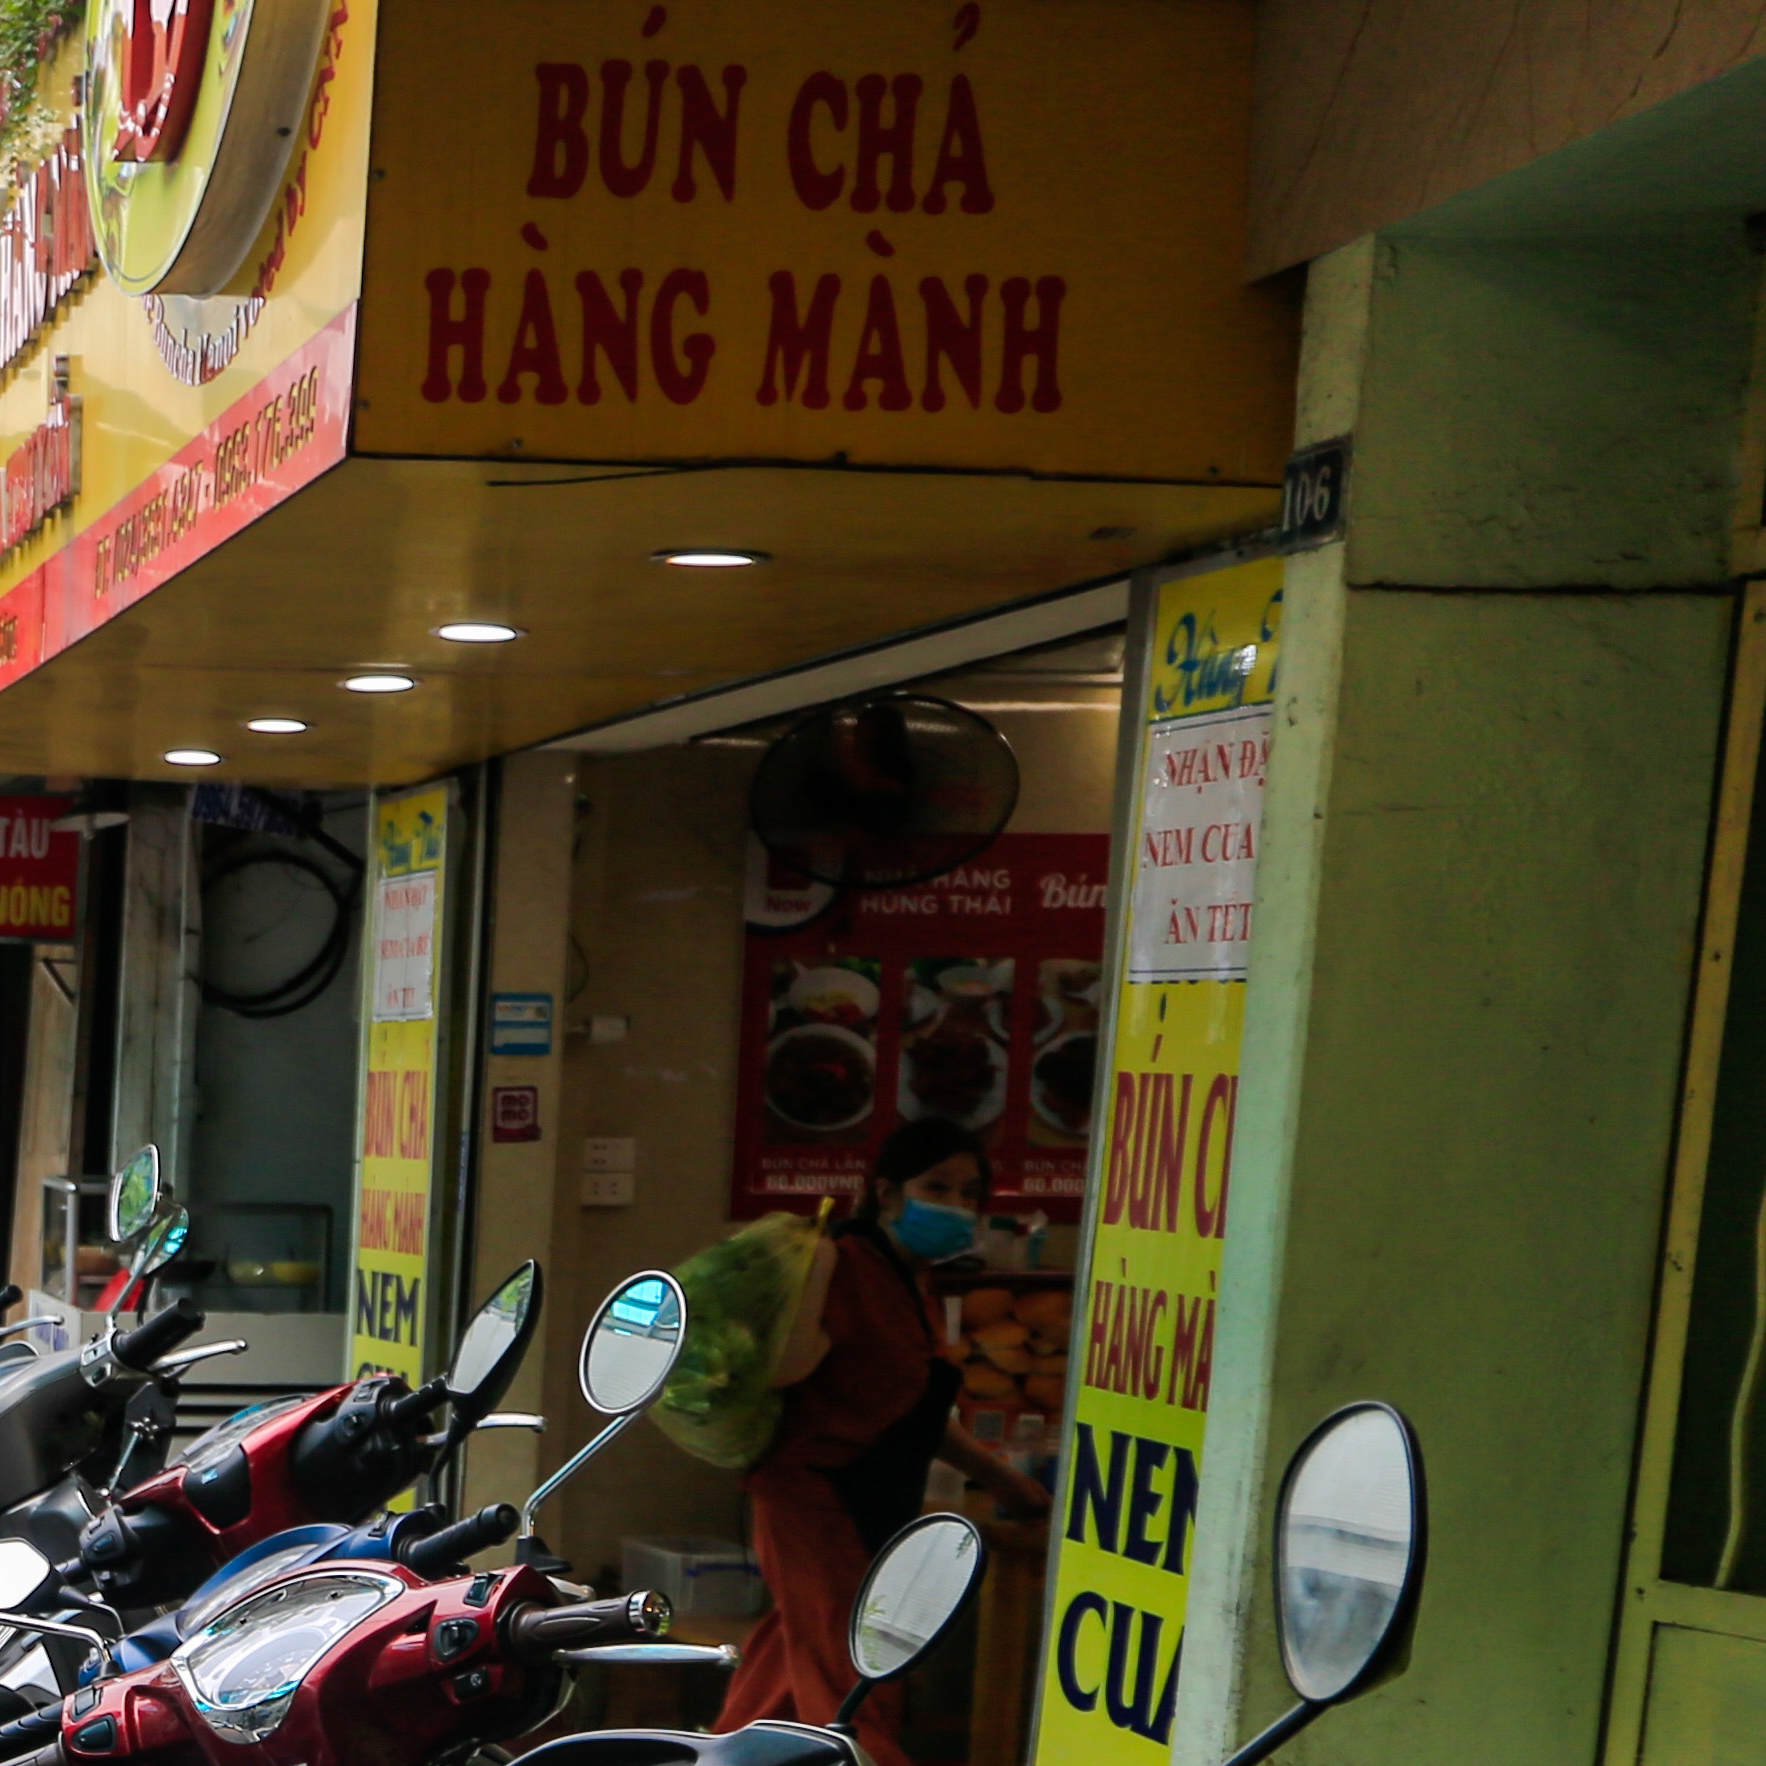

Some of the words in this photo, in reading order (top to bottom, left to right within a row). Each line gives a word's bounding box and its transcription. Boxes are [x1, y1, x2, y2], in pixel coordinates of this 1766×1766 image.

[526, 4, 746, 205] BÚN
[786, 2, 997, 215] CHẢ
[421, 222, 716, 406] HÀNG
[756, 229, 1067, 414] MÀNH
[1280, 472, 1334, 535] 106
[1165, 740, 1231, 794] NHẬN
[1239, 731, 1271, 786] ĐẶ
[1143, 827, 1194, 869] NEM
[1165, 897, 1200, 945] ĂN
[1103, 1032, 1192, 1235] BÚN
[356, 1269, 419, 1347] NEM
[1084, 1258, 1166, 1405] HÀNG
